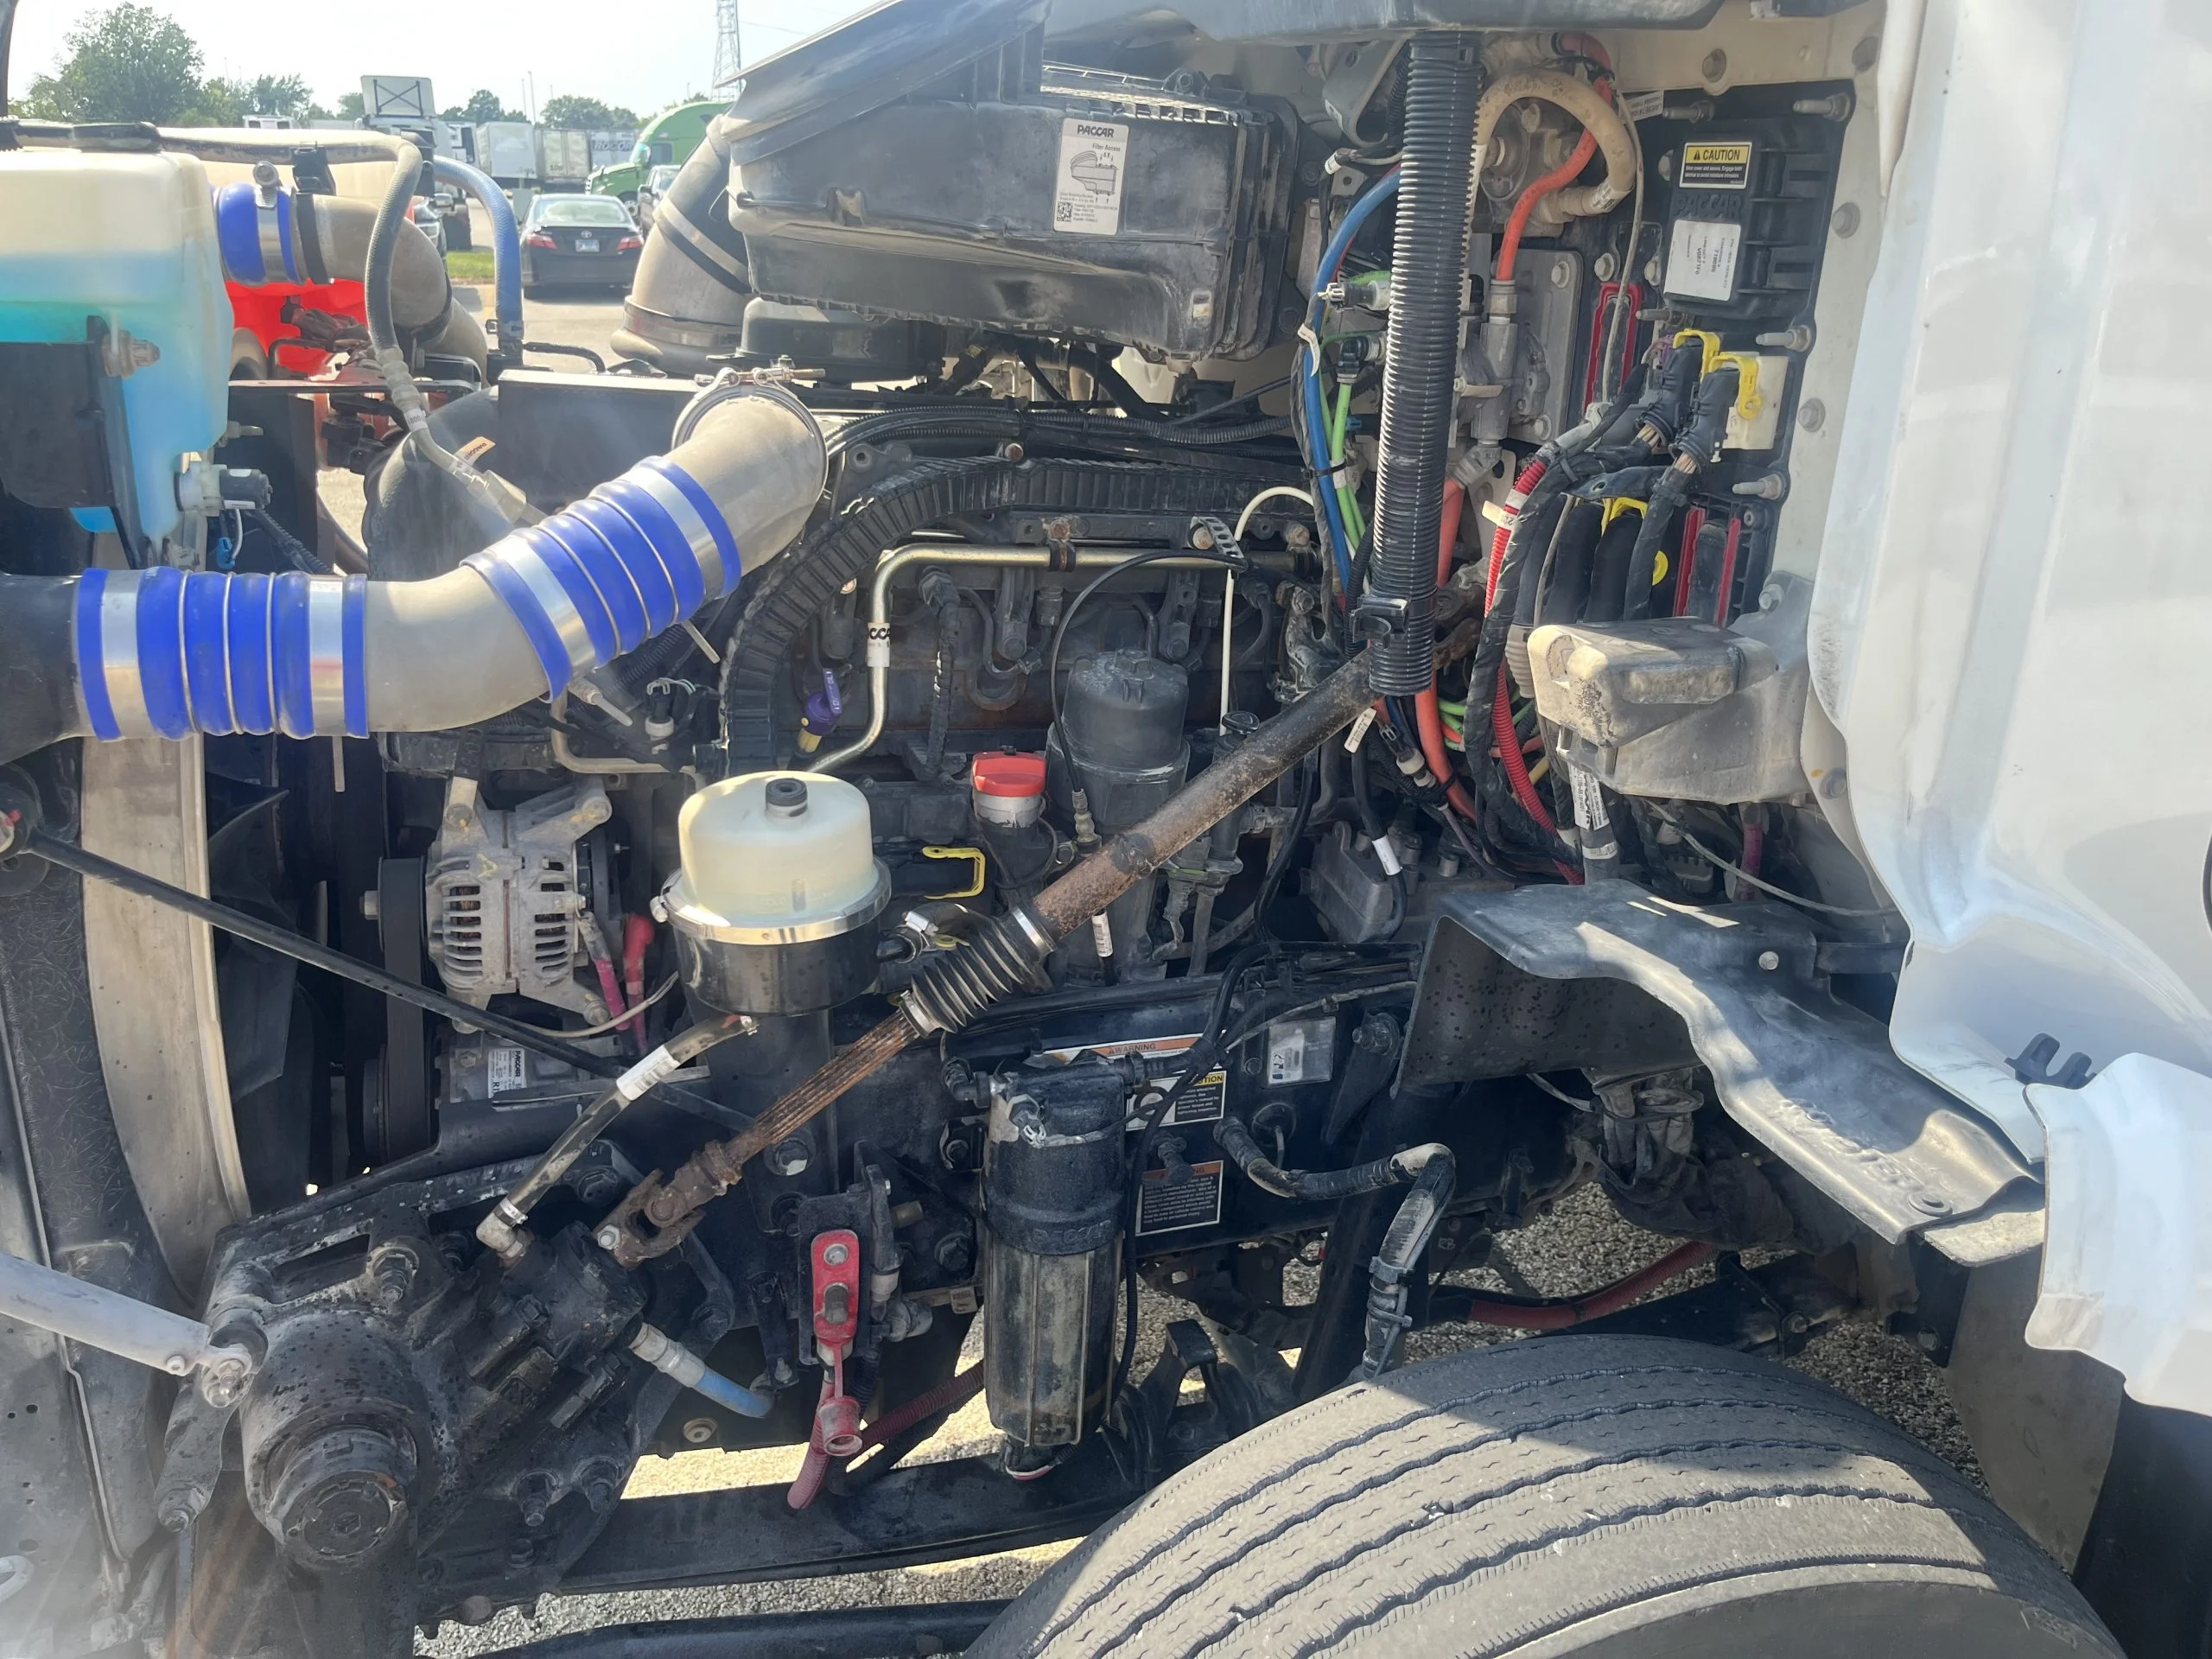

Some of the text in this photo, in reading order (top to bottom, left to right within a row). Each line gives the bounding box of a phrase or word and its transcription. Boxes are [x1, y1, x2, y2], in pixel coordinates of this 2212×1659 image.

[1077, 124, 1115, 138] PACCAR
[1702, 149, 1740, 161] CAUTION
[1676, 194, 1741, 217] PACCAR
[1114, 1042, 1156, 1053] WARNING
